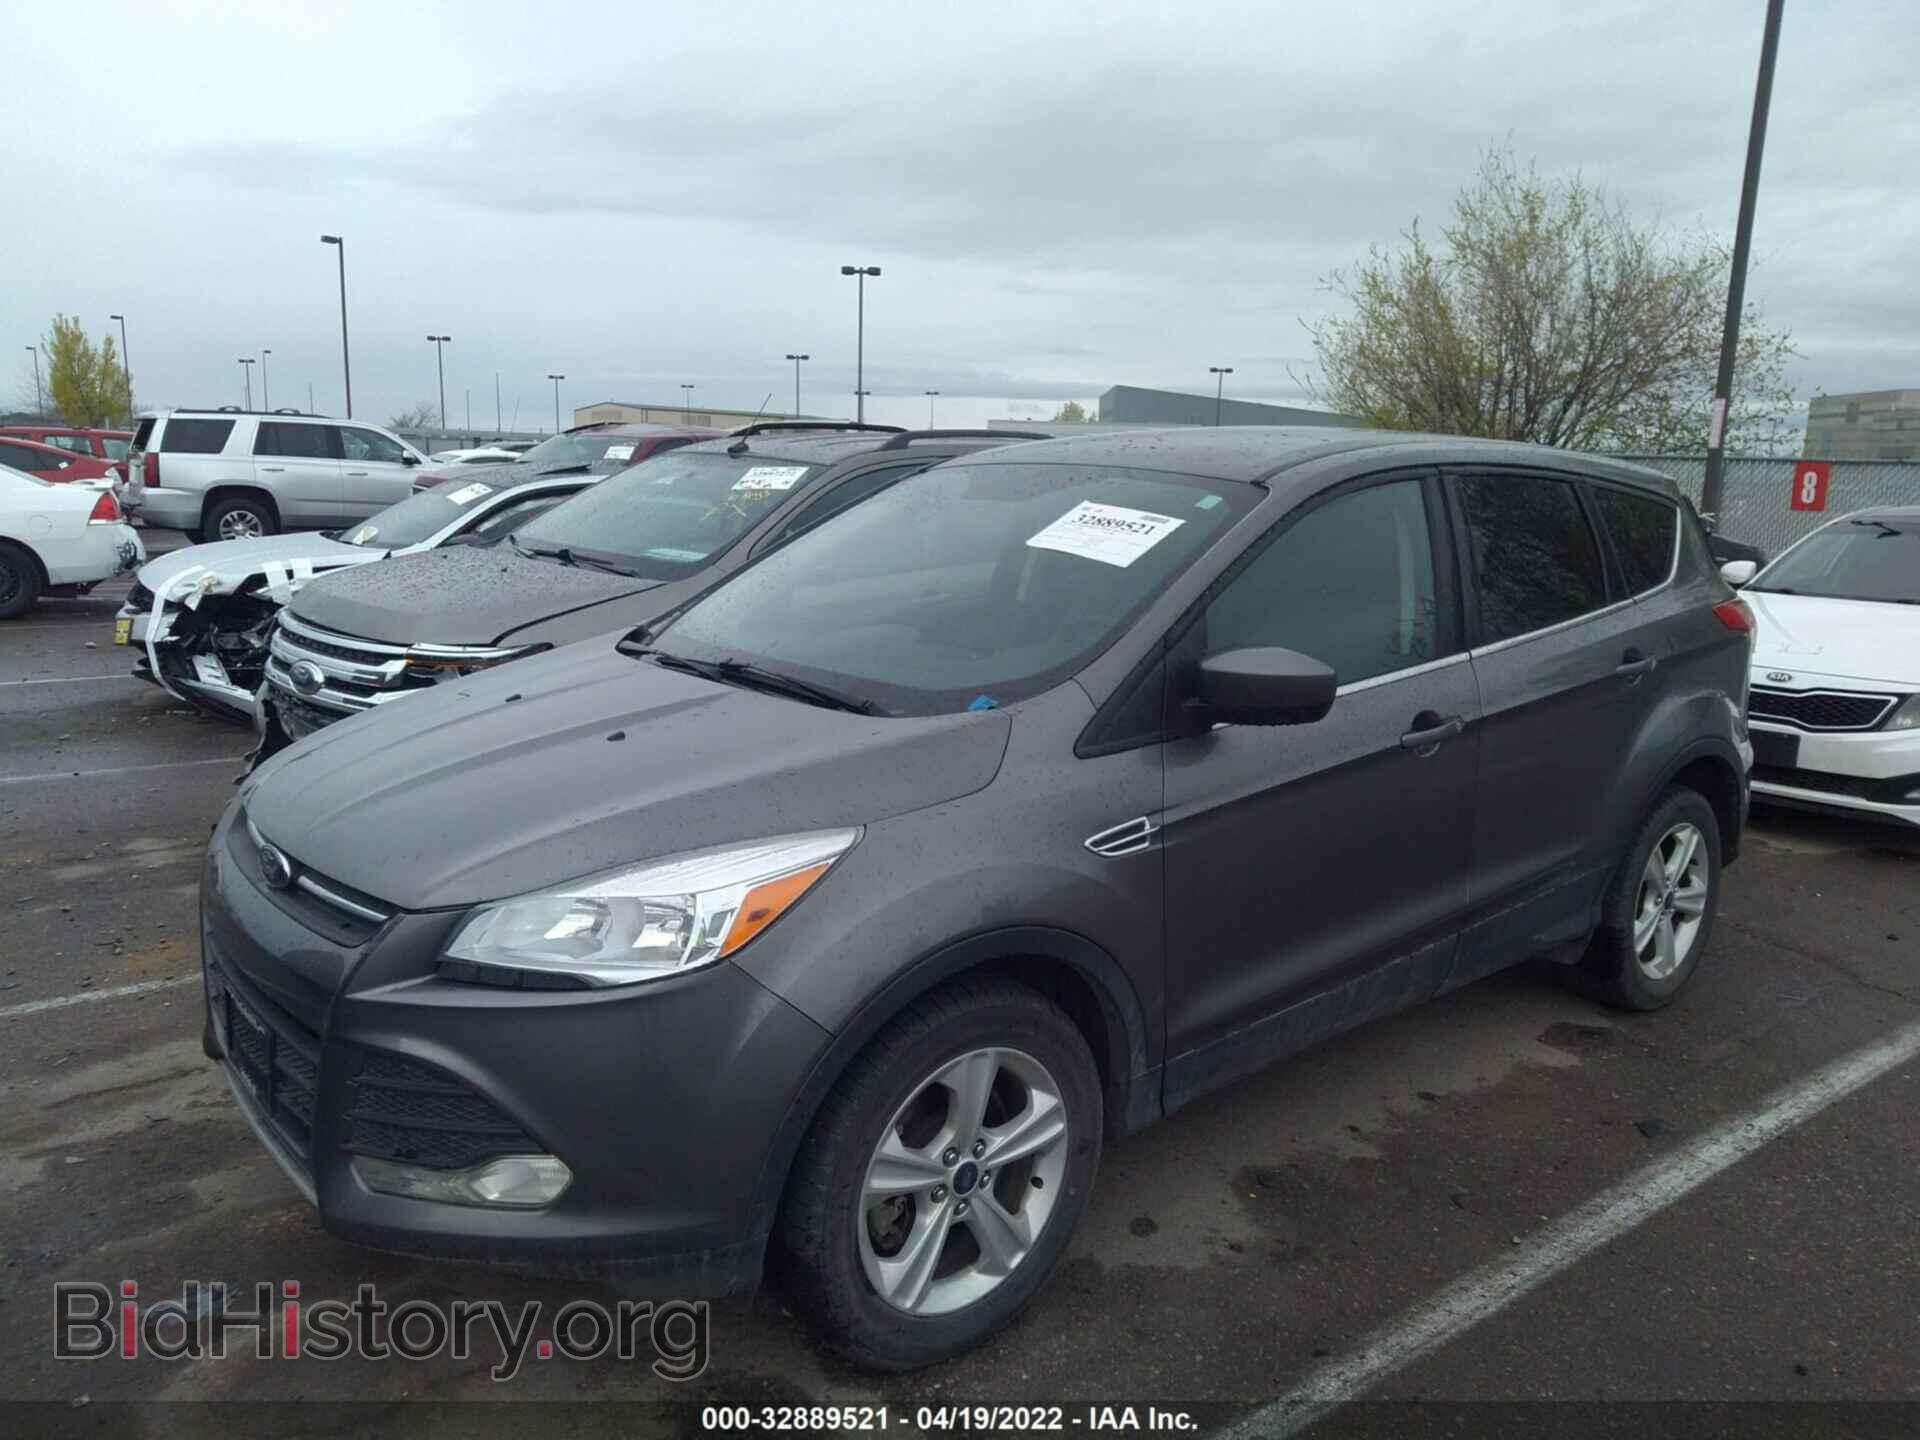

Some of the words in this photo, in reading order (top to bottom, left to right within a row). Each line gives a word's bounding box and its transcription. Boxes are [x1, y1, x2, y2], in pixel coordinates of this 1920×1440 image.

[1801, 471, 1818, 504] 8
[1072, 513, 1155, 535] 32889521
[1767, 672, 1791, 682] KIA
